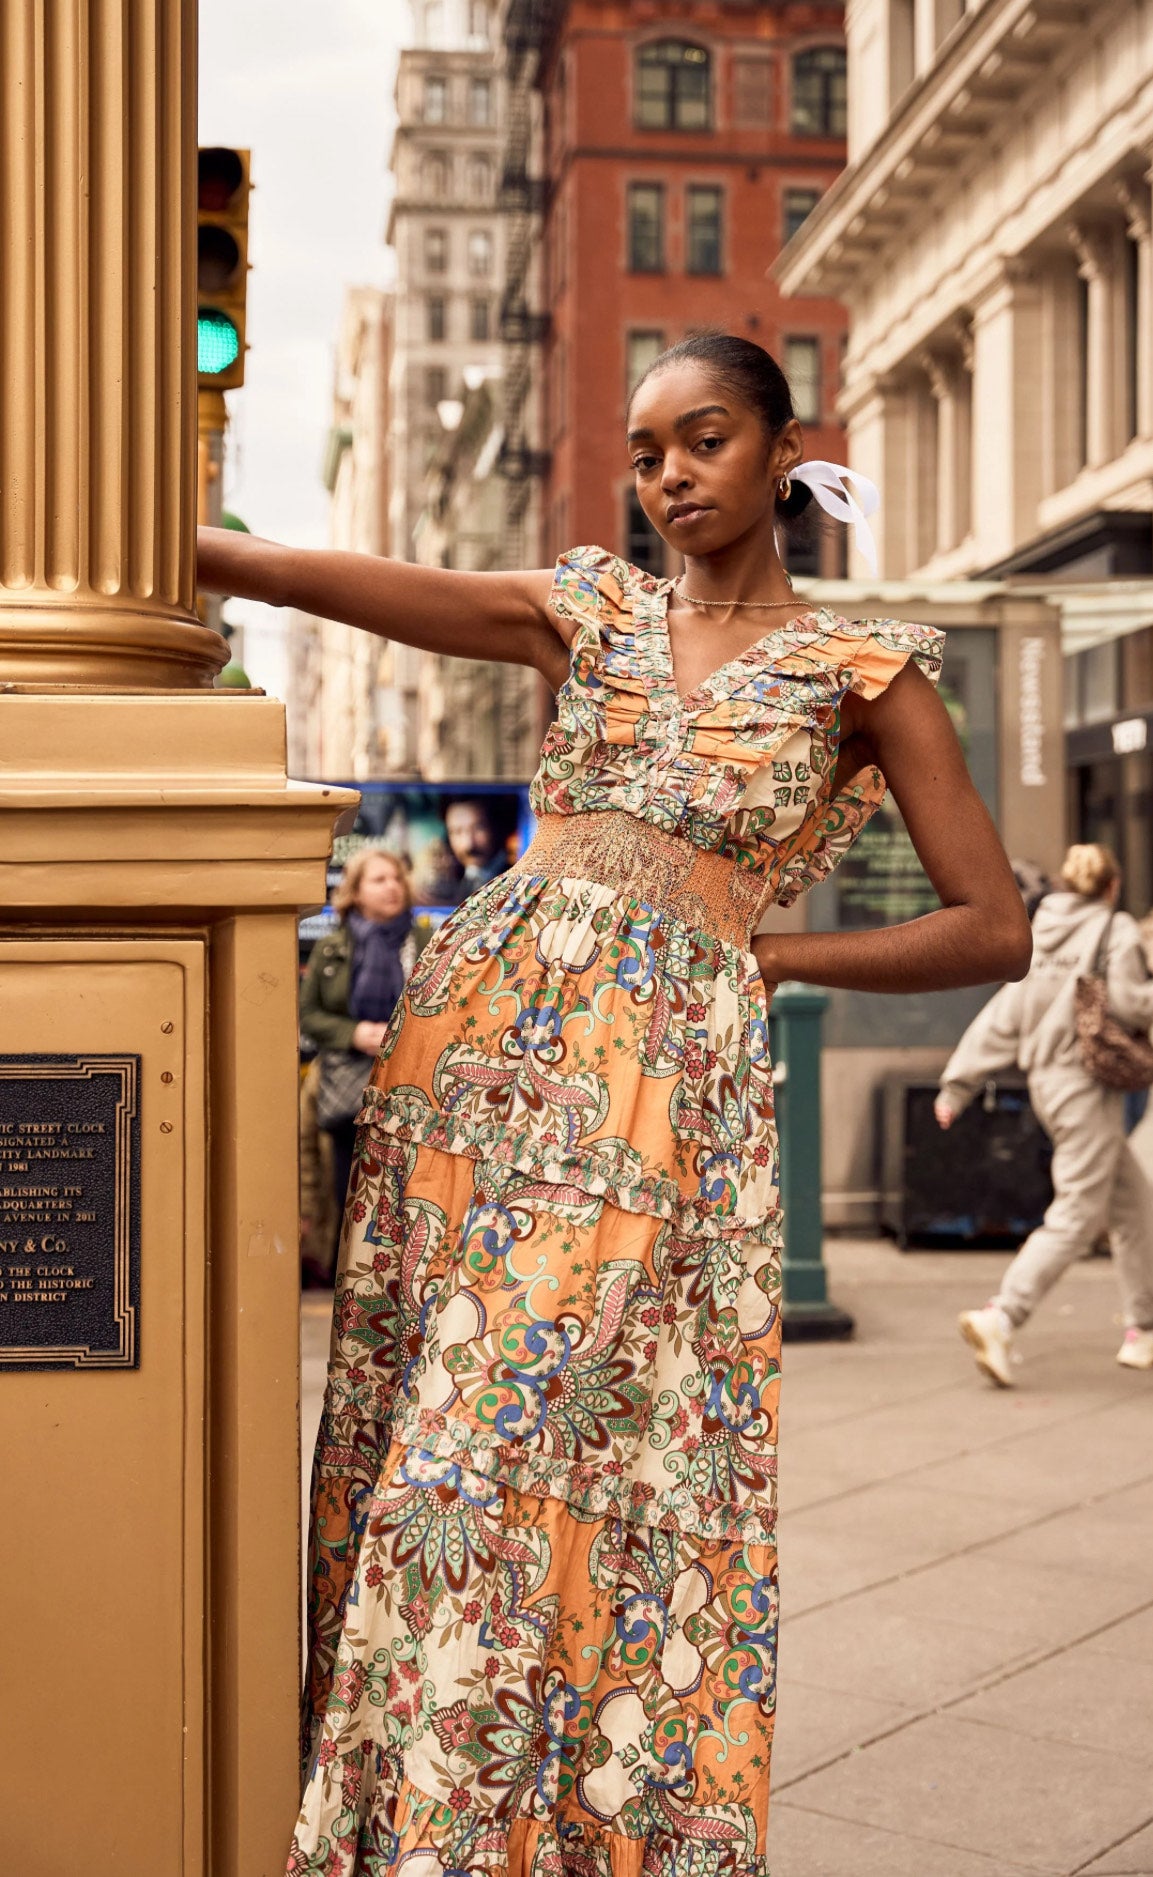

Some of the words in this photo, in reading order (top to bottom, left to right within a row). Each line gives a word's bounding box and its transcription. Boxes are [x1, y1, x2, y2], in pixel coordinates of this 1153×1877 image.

[19, 1124, 61, 1134] STREET
[67, 1124, 106, 1133] CLOCK
[61, 1137, 69, 1146] A
[27, 1150, 95, 1159] LANDMARK
[8, 1163, 29, 1172] 1981
[64, 1187, 82, 1196] ITS
[0, 1200, 73, 1211] DQUARTERS
[4, 1213, 51, 1222] AVENUE
[58, 1213, 70, 1222] IN
[76, 1213, 96, 1222] 2011
[24, 1239, 36, 1253] &
[8, 1267, 31, 1277] THE
[37, 1267, 75, 1276] CLOCK
[11, 1280, 33, 1289] THE
[39, 1279, 94, 1289] HISTORIC
[14, 1292, 67, 1302] DISTRICT
